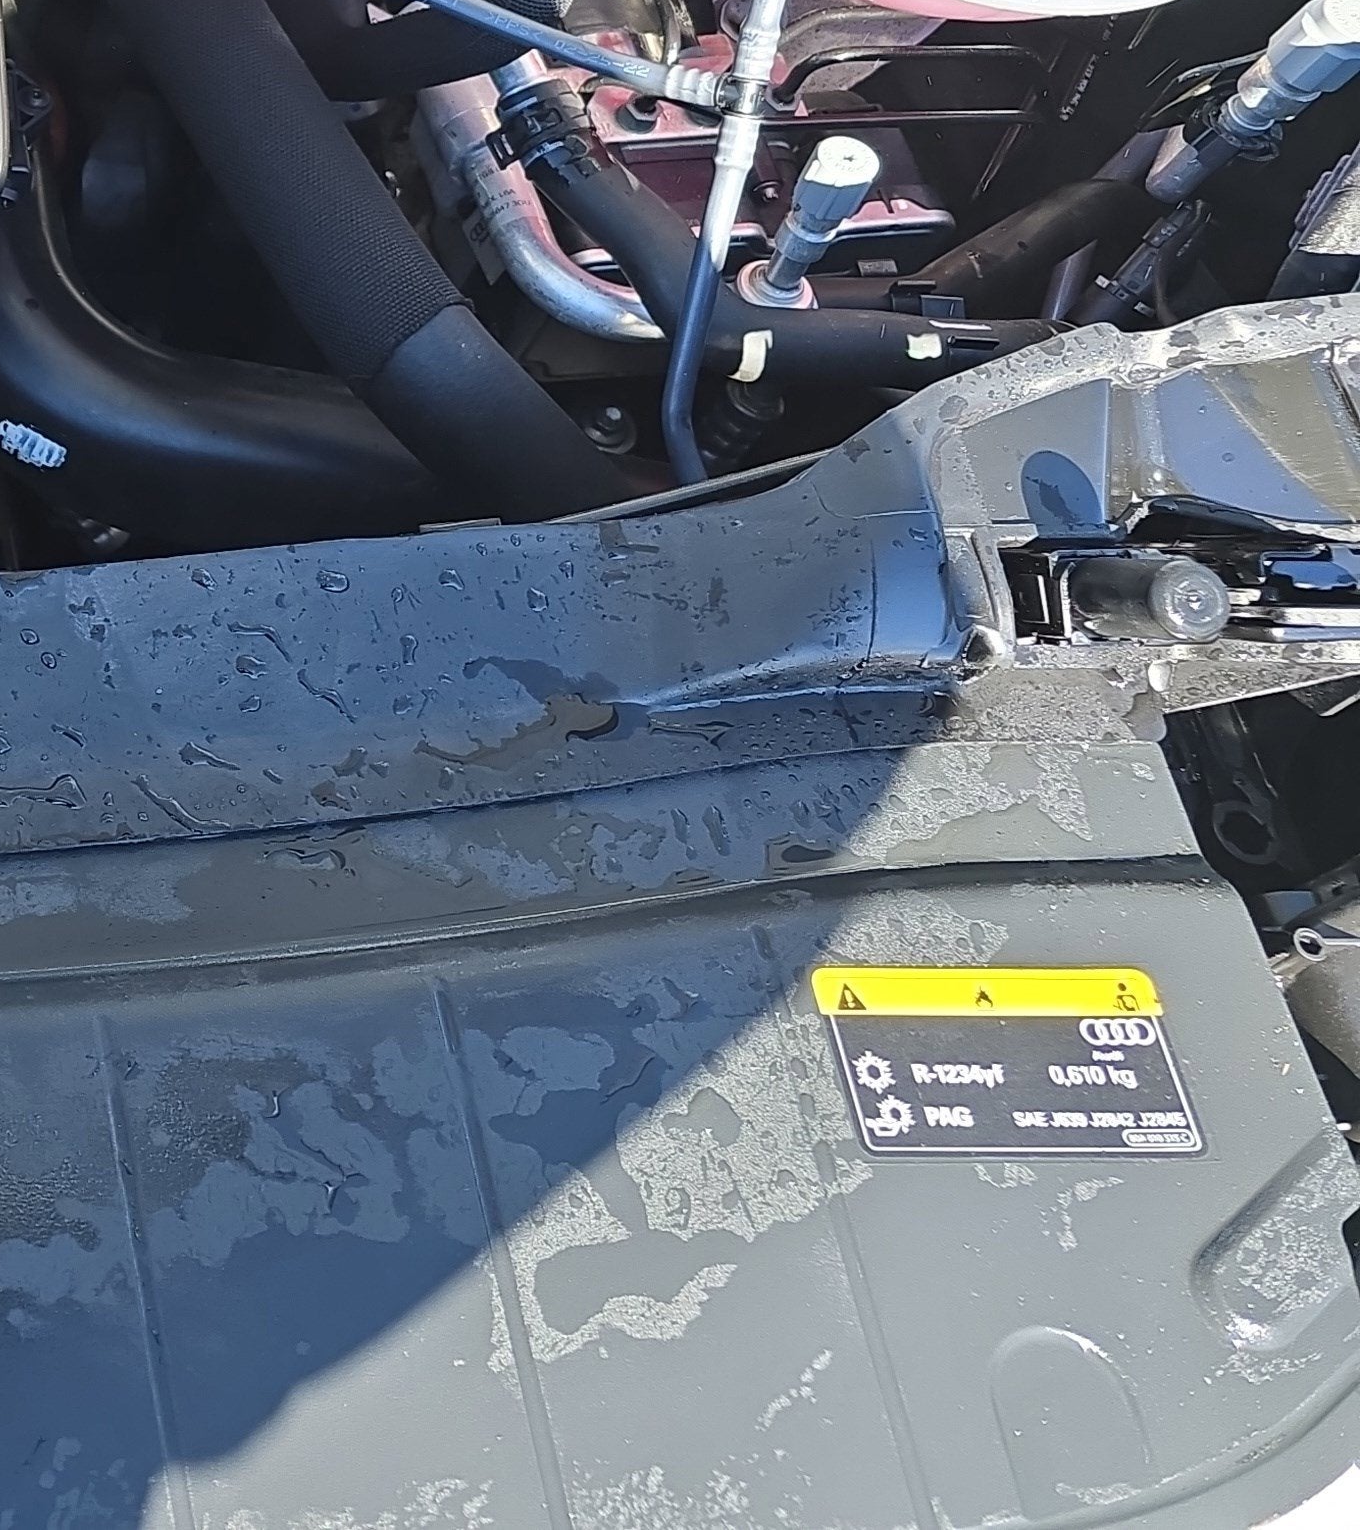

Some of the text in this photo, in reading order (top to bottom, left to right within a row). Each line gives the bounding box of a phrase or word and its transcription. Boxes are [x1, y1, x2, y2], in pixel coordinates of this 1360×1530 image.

[910, 1063, 1138, 1089] R-1234yf 0,610 kg
[923, 1106, 974, 1128] PAG
[1012, 1111, 1049, 1128] SAE
[1089, 1111, 1137, 1128] J2842
